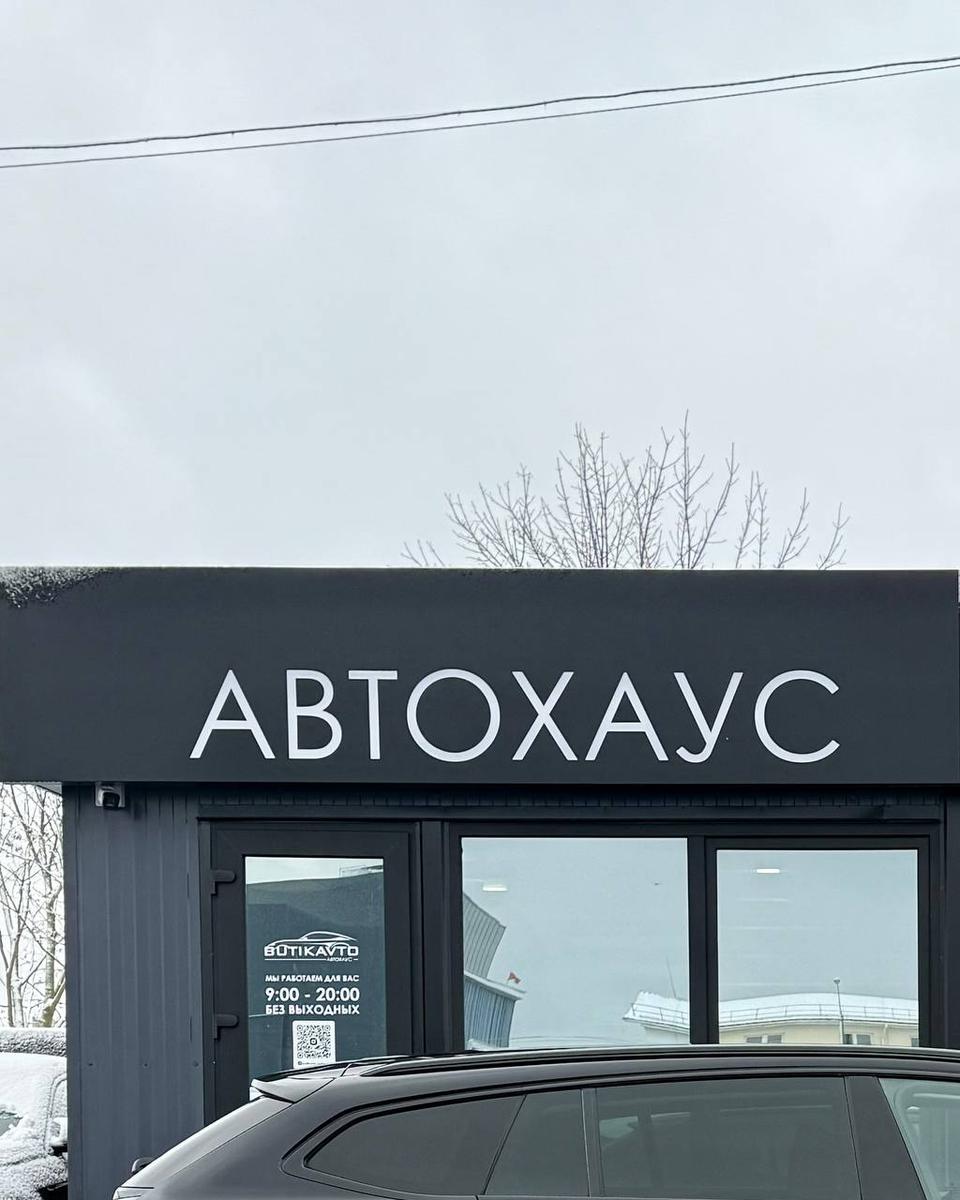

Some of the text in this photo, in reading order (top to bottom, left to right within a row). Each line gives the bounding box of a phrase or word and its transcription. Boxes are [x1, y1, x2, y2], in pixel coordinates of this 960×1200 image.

[189, 668, 841, 763] АВТОХАУС
[264, 945, 359, 957] BUTIKAVTO
[324, 975, 341, 983] ДЛЯ
[265, 987, 300, 1001] 9:00
[315, 987, 360, 1001] 20:00
[265, 1005, 360, 1015] БЕЗ ВЫХОДНЫХ
